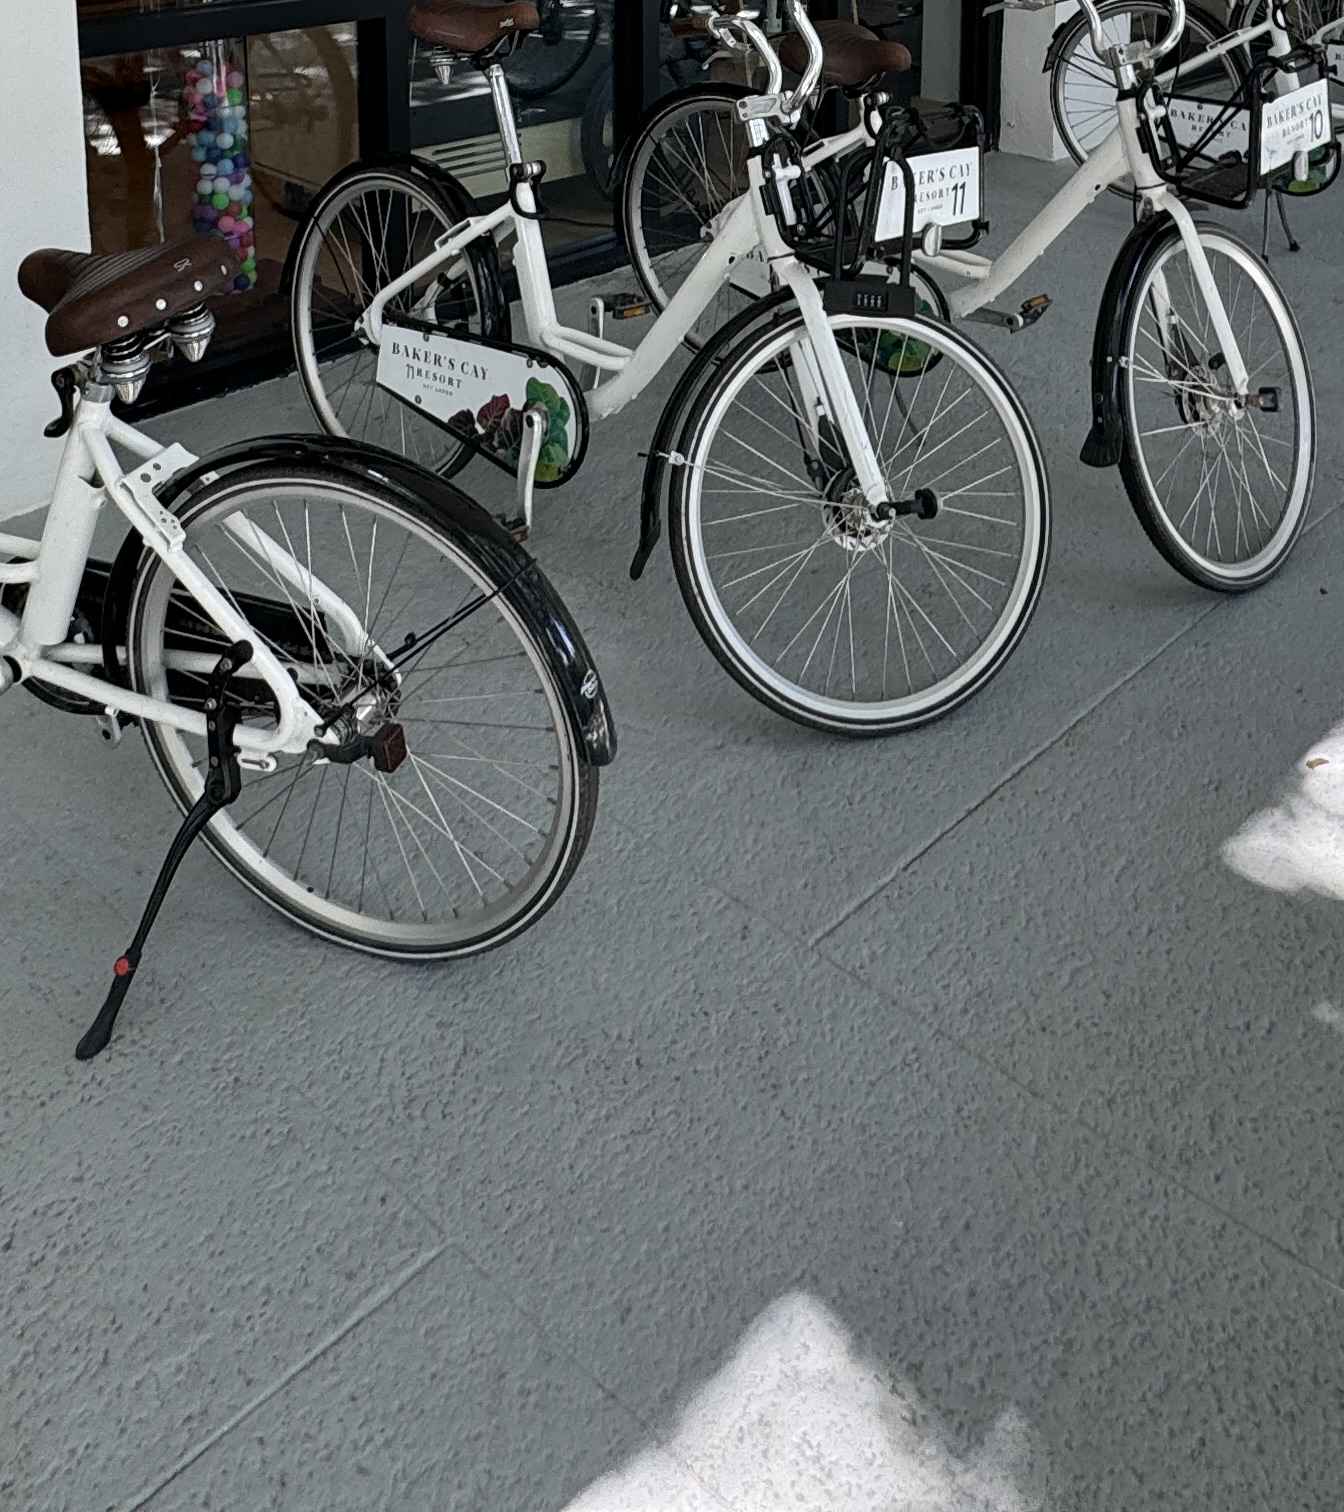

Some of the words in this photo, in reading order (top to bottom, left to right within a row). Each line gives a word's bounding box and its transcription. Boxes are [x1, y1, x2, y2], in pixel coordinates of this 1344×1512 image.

[1170, 108, 1223, 125] BAKER
[1230, 120, 1247, 132] CA
[1267, 101, 1304, 129] BAKER'S
[1306, 94, 1322, 111] CAY
[1309, 109, 1323, 143] 10
[1282, 118, 1308, 138] RESORT
[891, 167, 945, 191] BER'S
[949, 162, 974, 180] CAY
[951, 181, 966, 216] 11
[391, 341, 455, 371] BAKER'S
[460, 361, 489, 381] CAY
[416, 367, 462, 389] RESORT
